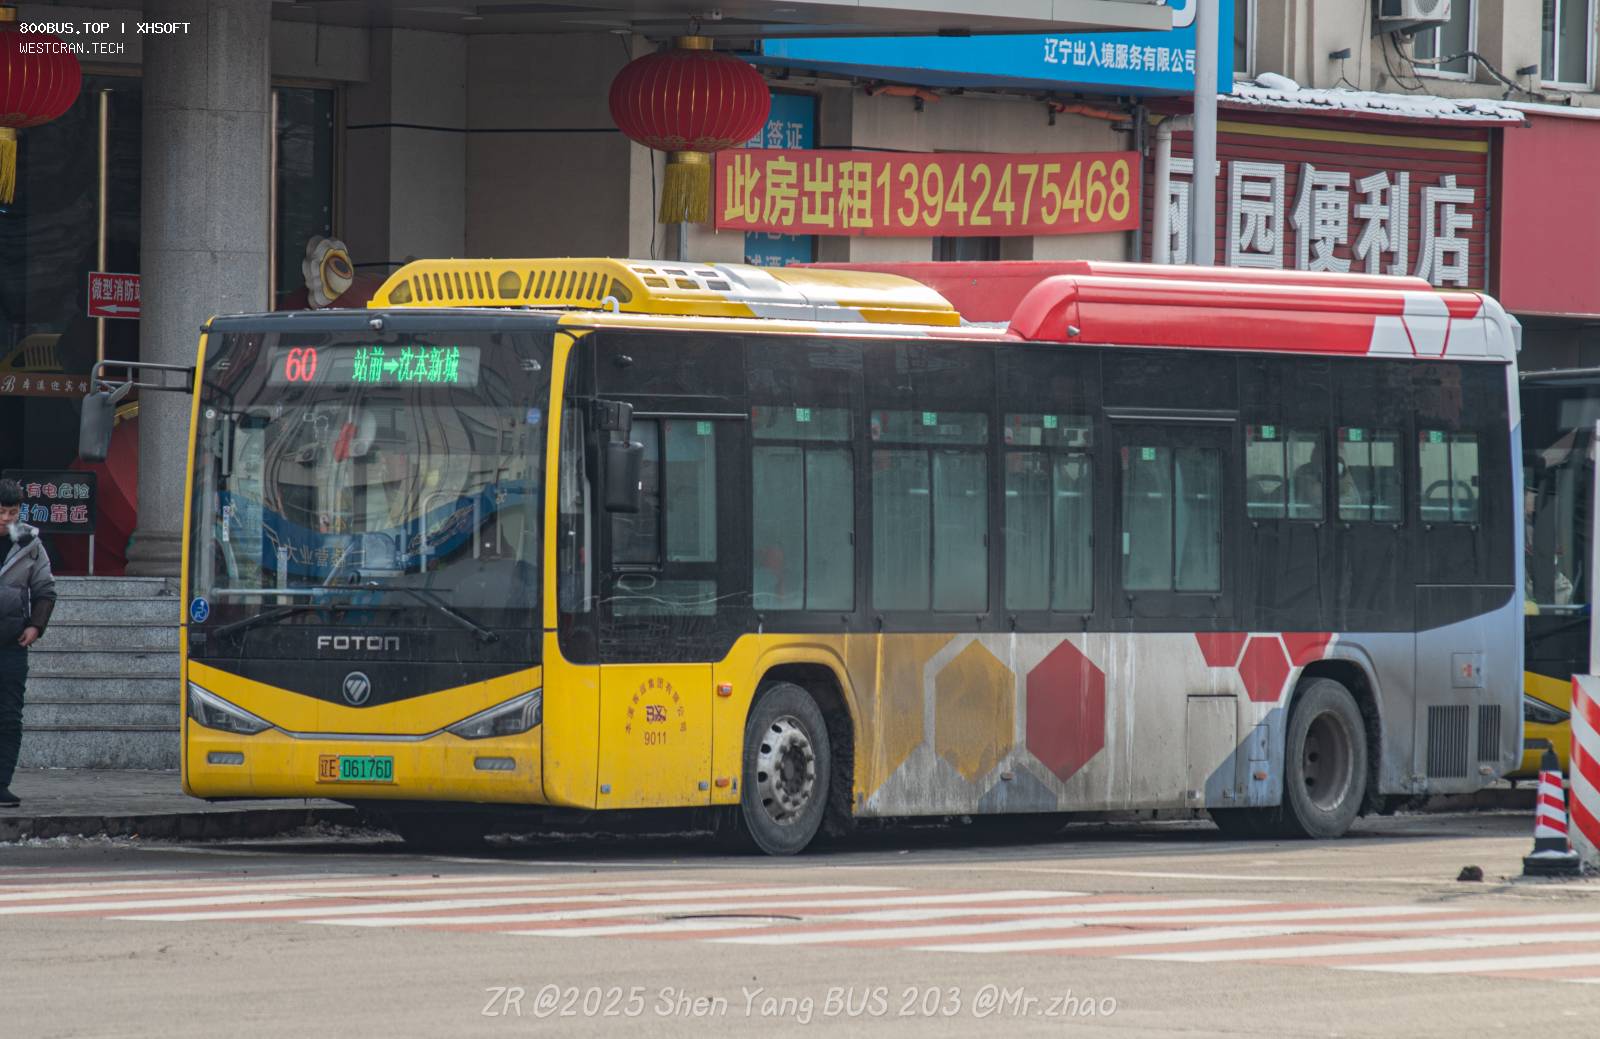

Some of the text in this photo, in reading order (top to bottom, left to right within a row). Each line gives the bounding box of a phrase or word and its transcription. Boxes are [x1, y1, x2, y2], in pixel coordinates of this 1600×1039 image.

[1044, 37, 1196, 74] 辽宁出入境服务有限公司
[724, 153, 1131, 229] 此房出租13942475468
[285, 347, 318, 382] 60
[26, 482, 90, 499] 有电危险
[317, 636, 400, 651] FOTON
[644, 731, 667, 746] 9011
